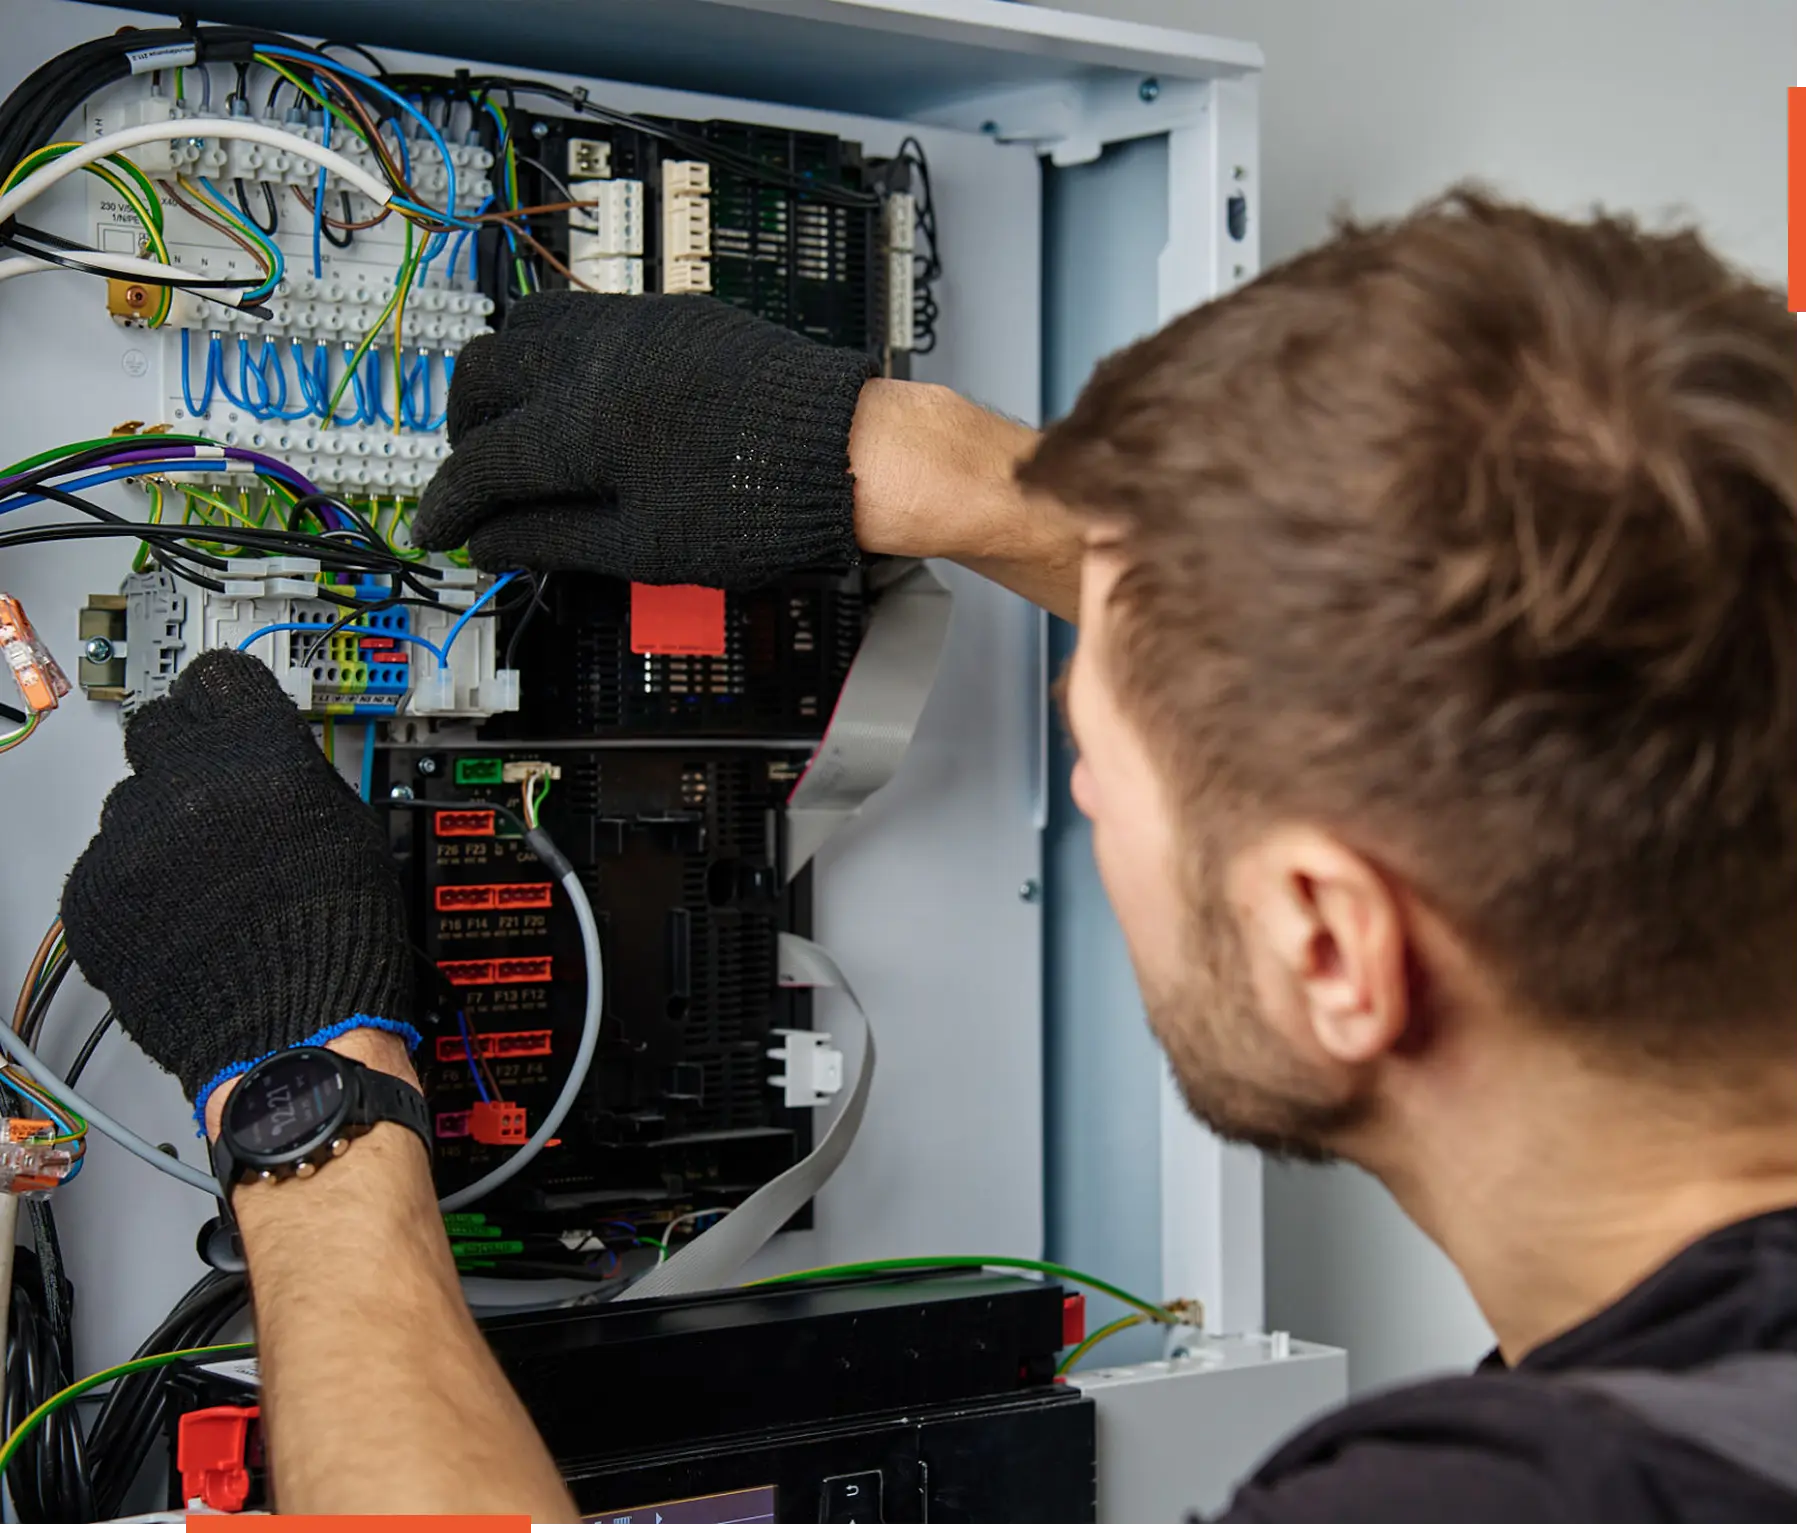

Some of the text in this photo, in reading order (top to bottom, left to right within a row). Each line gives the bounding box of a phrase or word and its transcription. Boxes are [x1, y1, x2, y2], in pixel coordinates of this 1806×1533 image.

[99, 201, 116, 211] 230
[174, 255, 182, 264] N
[201, 258, 209, 267] N
[465, 842, 487, 856] F23
[467, 916, 488, 929] F14
[498, 915, 520, 928] F21
[524, 914, 546, 927] F20
[466, 988, 546, 1005] F7 F13 F12
